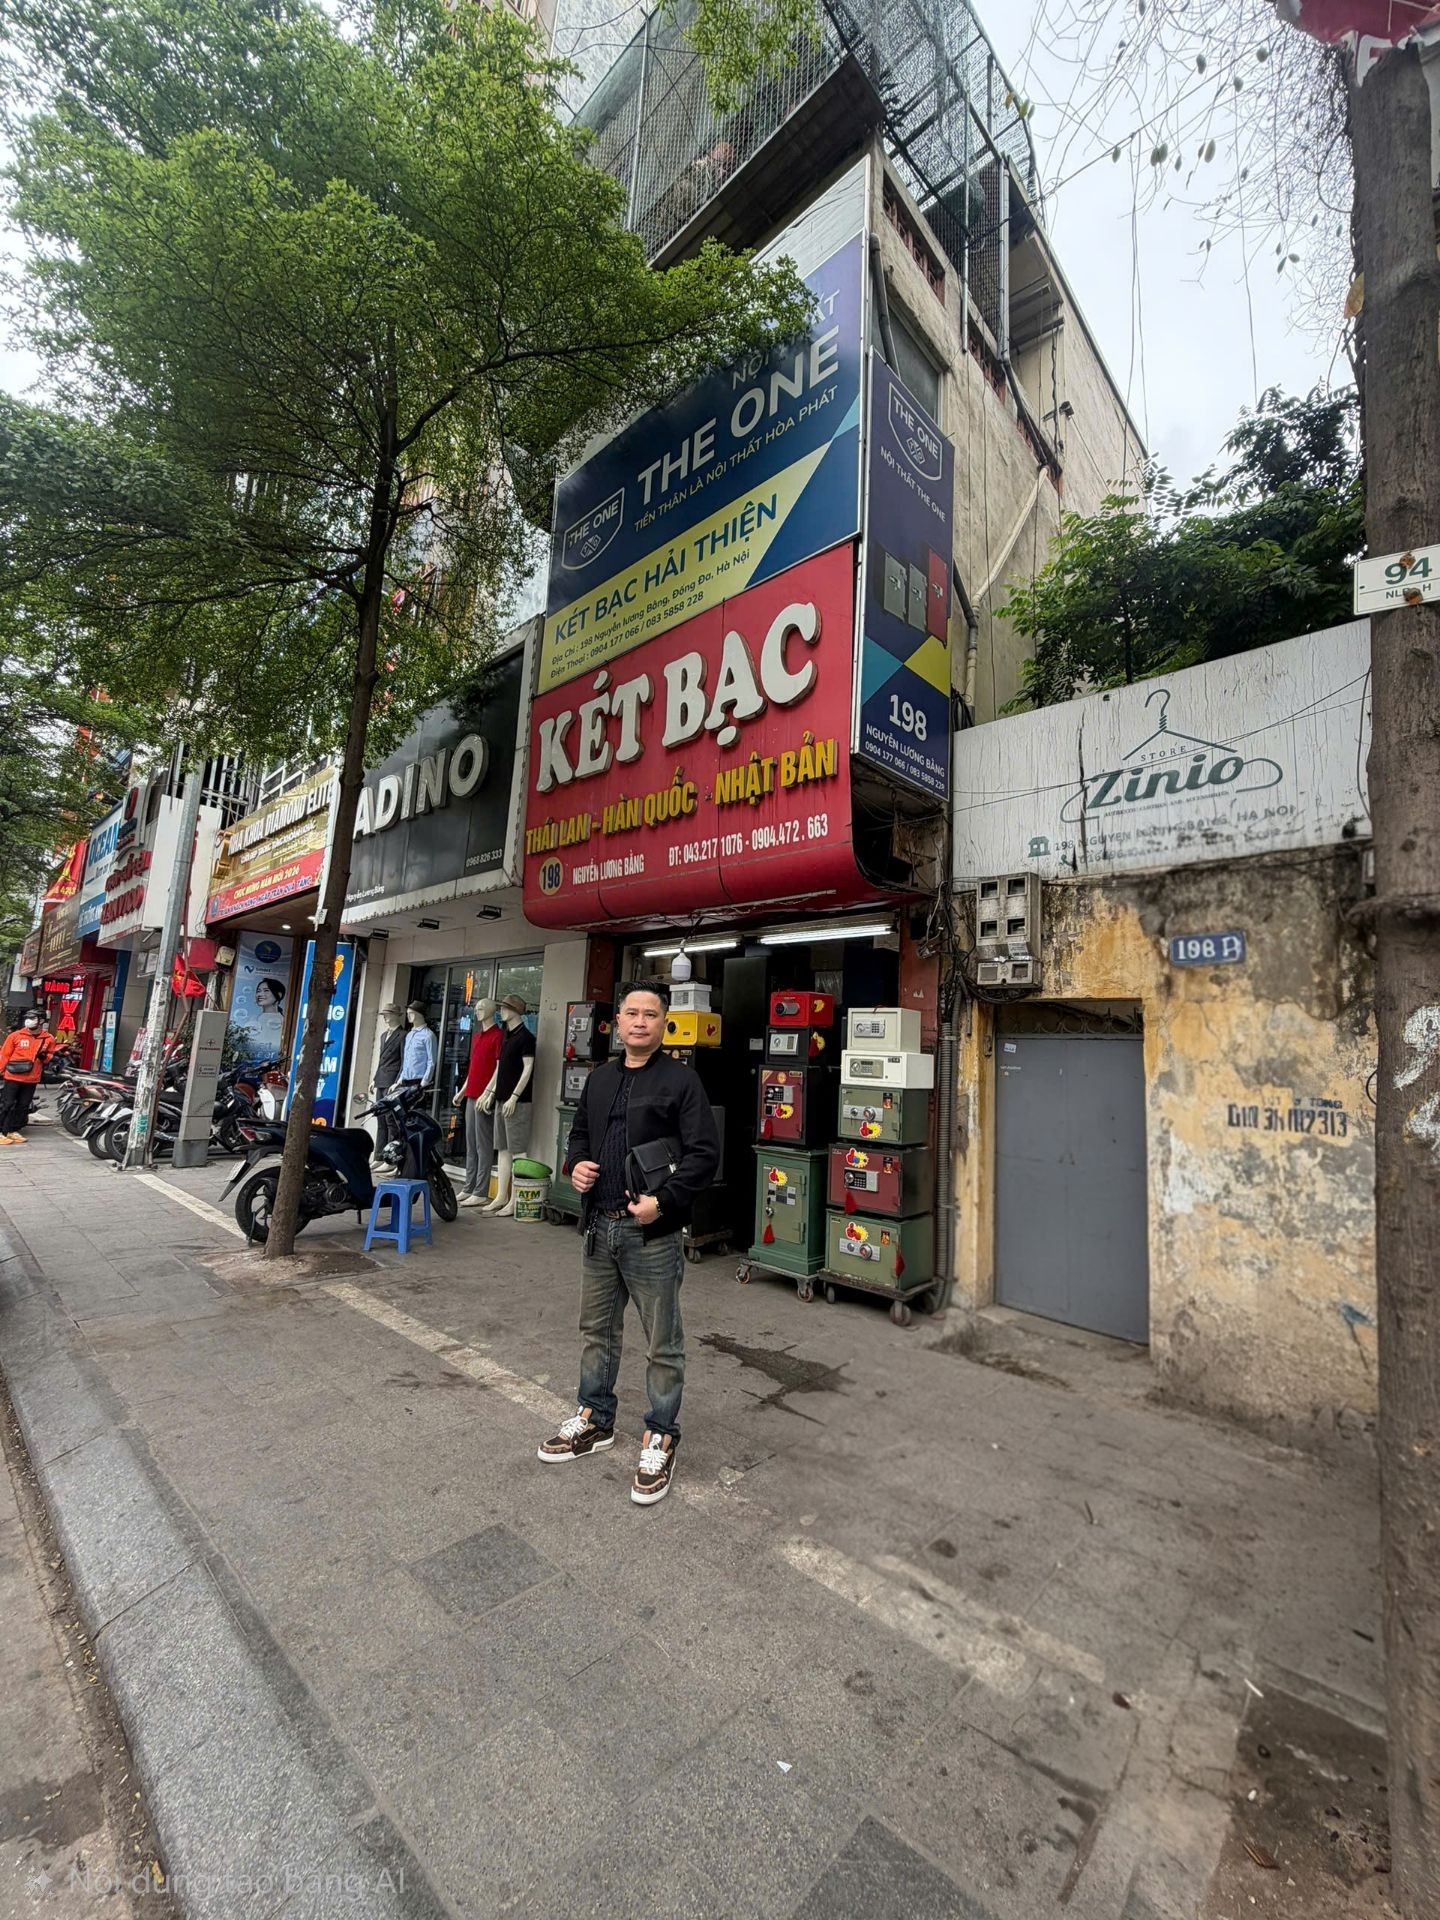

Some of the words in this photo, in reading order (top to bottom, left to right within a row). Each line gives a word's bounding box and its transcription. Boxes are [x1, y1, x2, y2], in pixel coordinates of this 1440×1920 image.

[637, 418, 717, 506] THE
[731, 325, 839, 438] ONE
[893, 395, 915, 432] THE
[917, 427, 939, 460] ONE
[634, 508, 656, 532] TIỀN
[658, 488, 687, 516] THÂN
[689, 479, 704, 498] LÀ
[706, 463, 727, 487] NỘI
[729, 436, 761, 465] THẤT
[765, 415, 795, 445] HÒA
[799, 385, 838, 422] PHÁT
[880, 446, 895, 469] NỘI
[896, 462, 916, 490] THẤT
[916, 484, 931, 507] THE
[931, 501, 946, 523] ONE
[568, 524, 590, 548] THE
[593, 500, 619, 529] ONE
[555, 606, 590, 645] KÉT
[595, 578, 638, 622] BẠC
[644, 548, 687, 593] HẢI
[694, 493, 777, 562] THIỆN
[1384, 556, 1432, 585] 94
[580, 638, 593, 651] 198
[732, 549, 751, 566] Nội
[590, 642, 608, 657] 0904
[609, 633, 624, 649] 177
[624, 626, 641, 640] 066
[646, 613, 663, 629] 083
[663, 602, 686, 621] 5858
[687, 591, 704, 608] 228
[536, 670, 653, 793] KÉT
[662, 601, 822, 749] BẠC
[889, 694, 927, 741] 198
[865, 741, 881, 756] 0904
[882, 750, 894, 762] 177
[900, 742, 925, 766] LƯƠNG
[1140, 745, 1187, 761] STORE
[526, 817, 558, 855] THÁI
[559, 813, 592, 844] LAN
[602, 793, 641, 835] HÀN
[644, 766, 698, 826] QUỐC
[714, 751, 777, 807] NHẬT
[781, 730, 838, 788] BẢN
[1086, 754, 1245, 809] Zinio
[1055, 839, 1074, 851] 198
[1237, 811, 1258, 822] HA
[540, 863, 562, 890] 198
[572, 860, 599, 885] NGUYỄN
[600, 855, 623, 881] LƯƠNG
[624, 849, 644, 876] BẰNG
[669, 847, 682, 867] ĐT:
[720, 833, 743, 857] 1076
[518, 1190, 541, 1199] ATM
